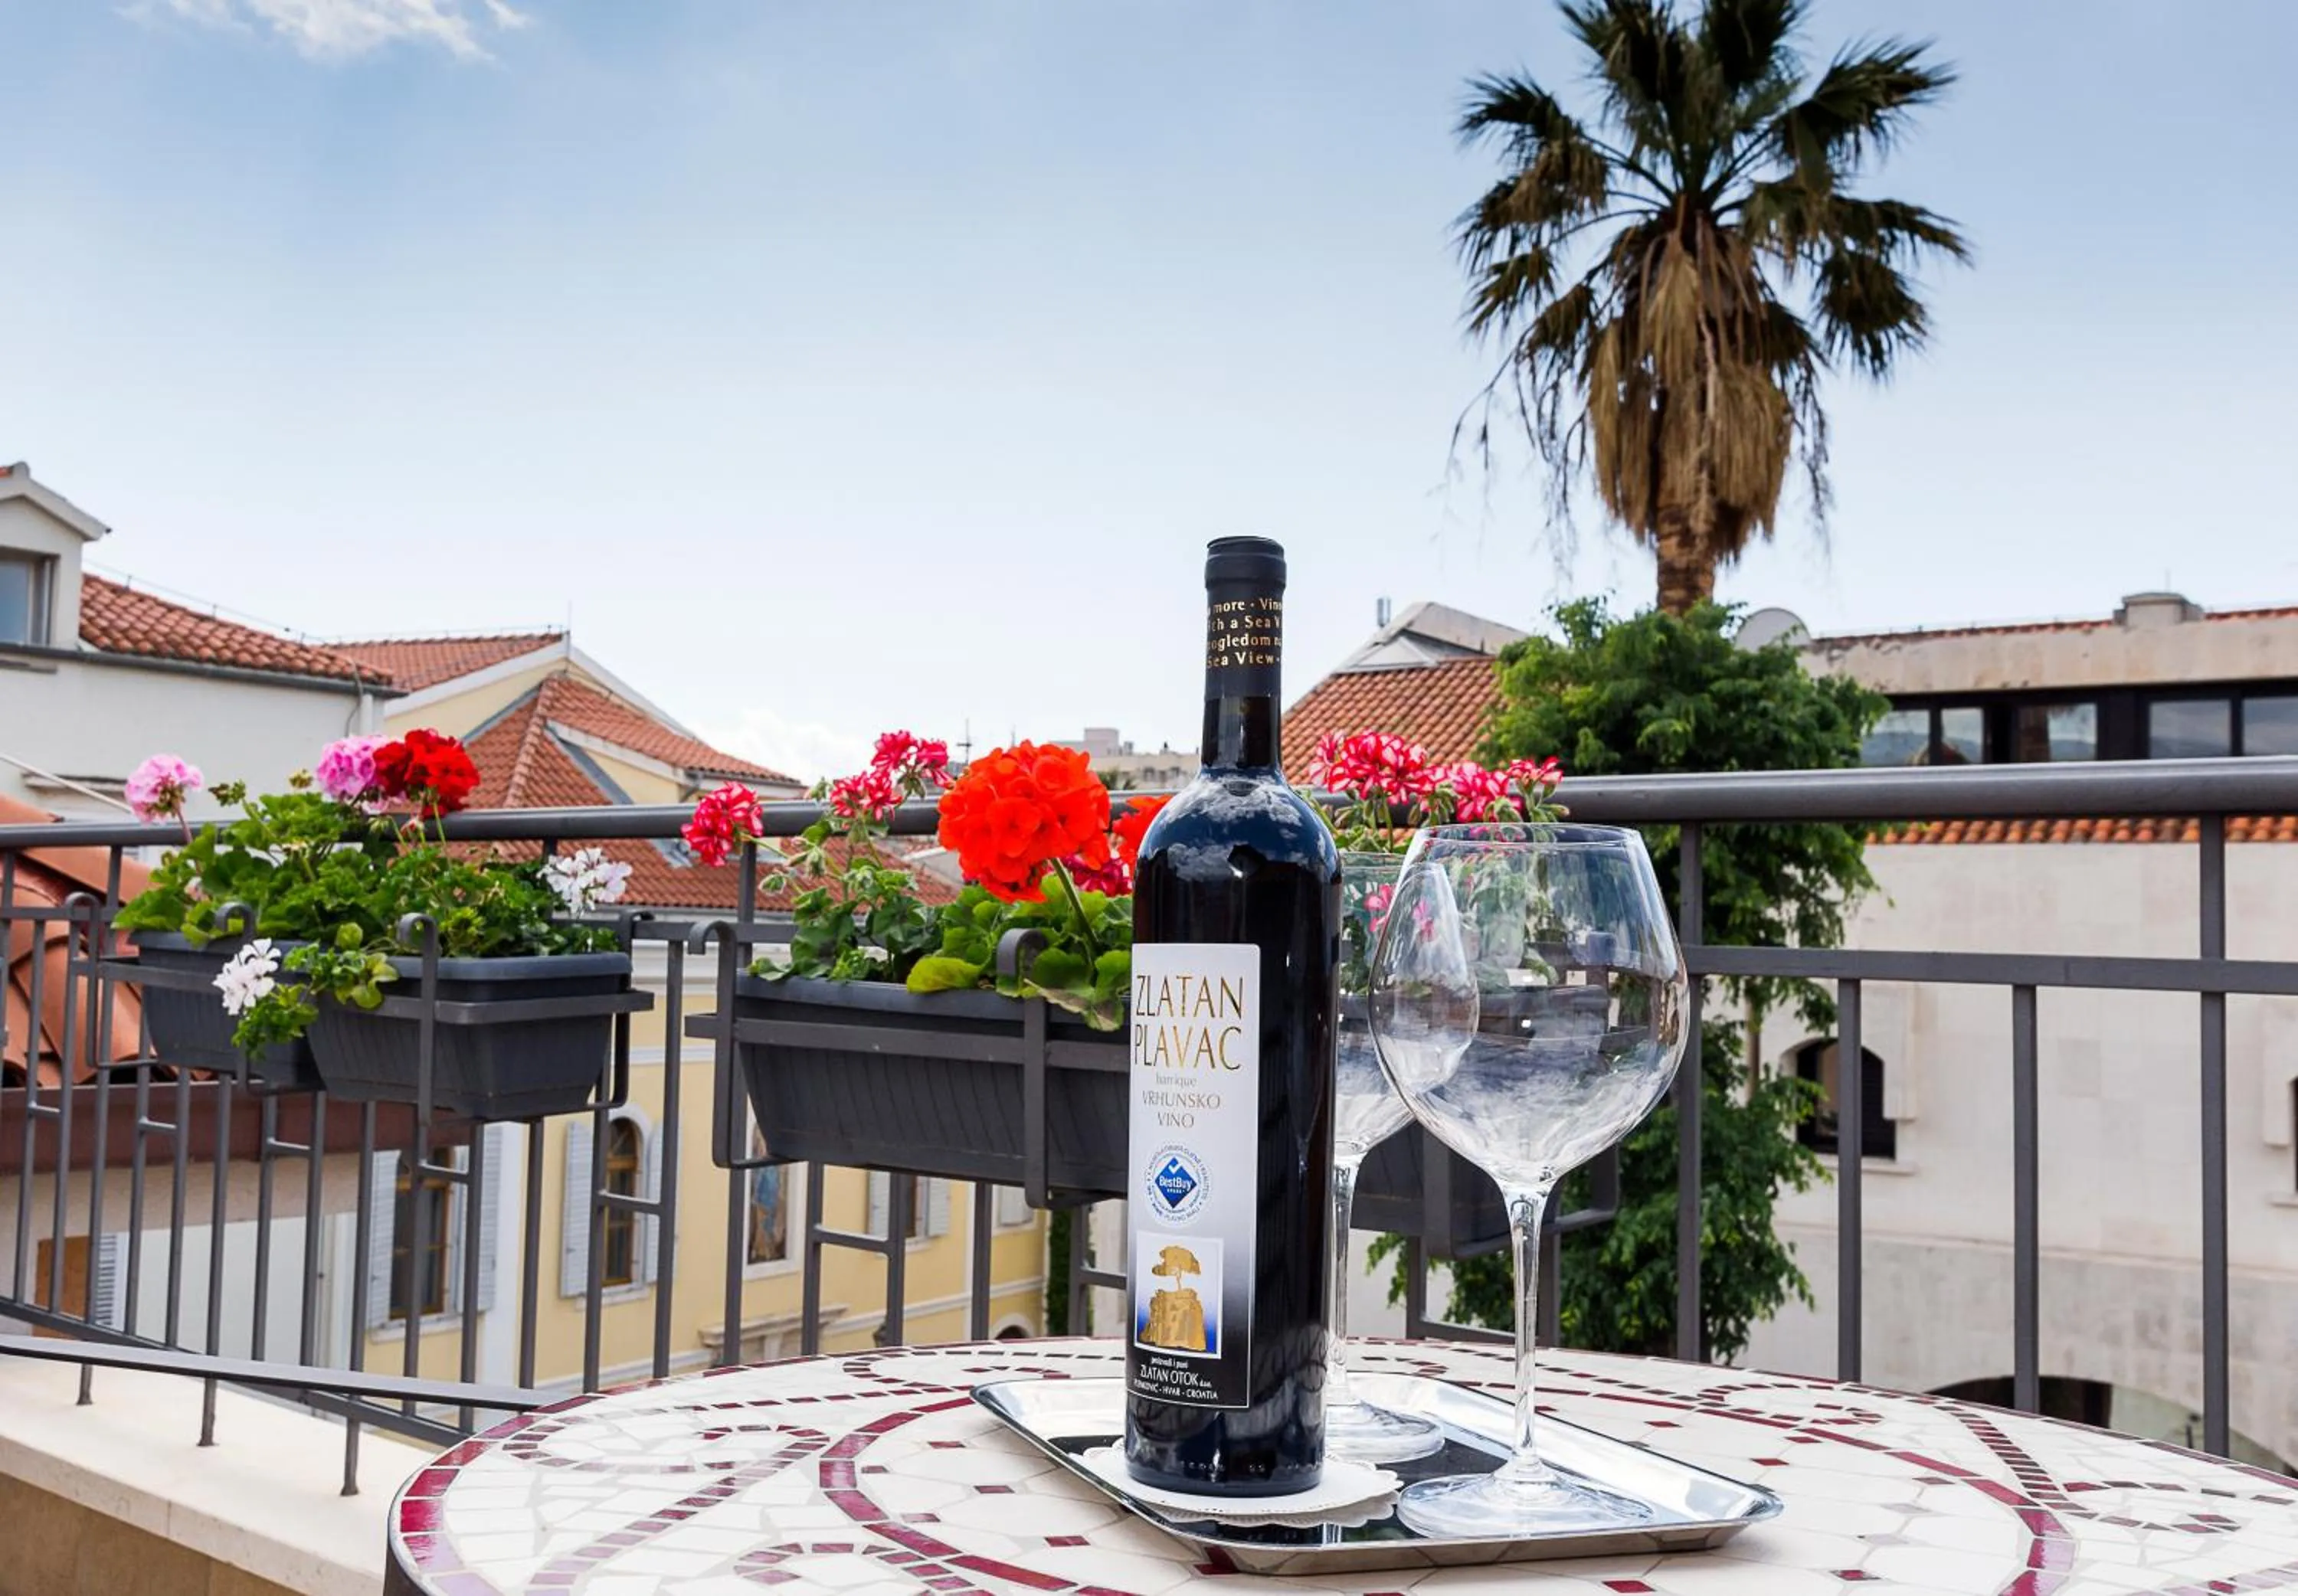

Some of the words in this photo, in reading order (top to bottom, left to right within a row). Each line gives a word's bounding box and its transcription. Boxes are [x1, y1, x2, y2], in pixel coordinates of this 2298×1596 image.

[1213, 601, 1245, 613] more
[1230, 619, 1239, 629] a
[1245, 615, 1271, 629] Sea
[1235, 651, 1275, 666] View
[1136, 975, 1244, 1019] ZLATAN
[1134, 1024, 1242, 1071] PLAVAC
[1142, 1090, 1221, 1110] VRHUNSKO
[1157, 1111, 1195, 1128] VINO
[1140, 1364, 1170, 1382] ZLATAN
[1170, 1370, 1199, 1387] OTOK
[1162, 1385, 1180, 1396] HVAR
[1186, 1388, 1219, 1400] CROATIA
